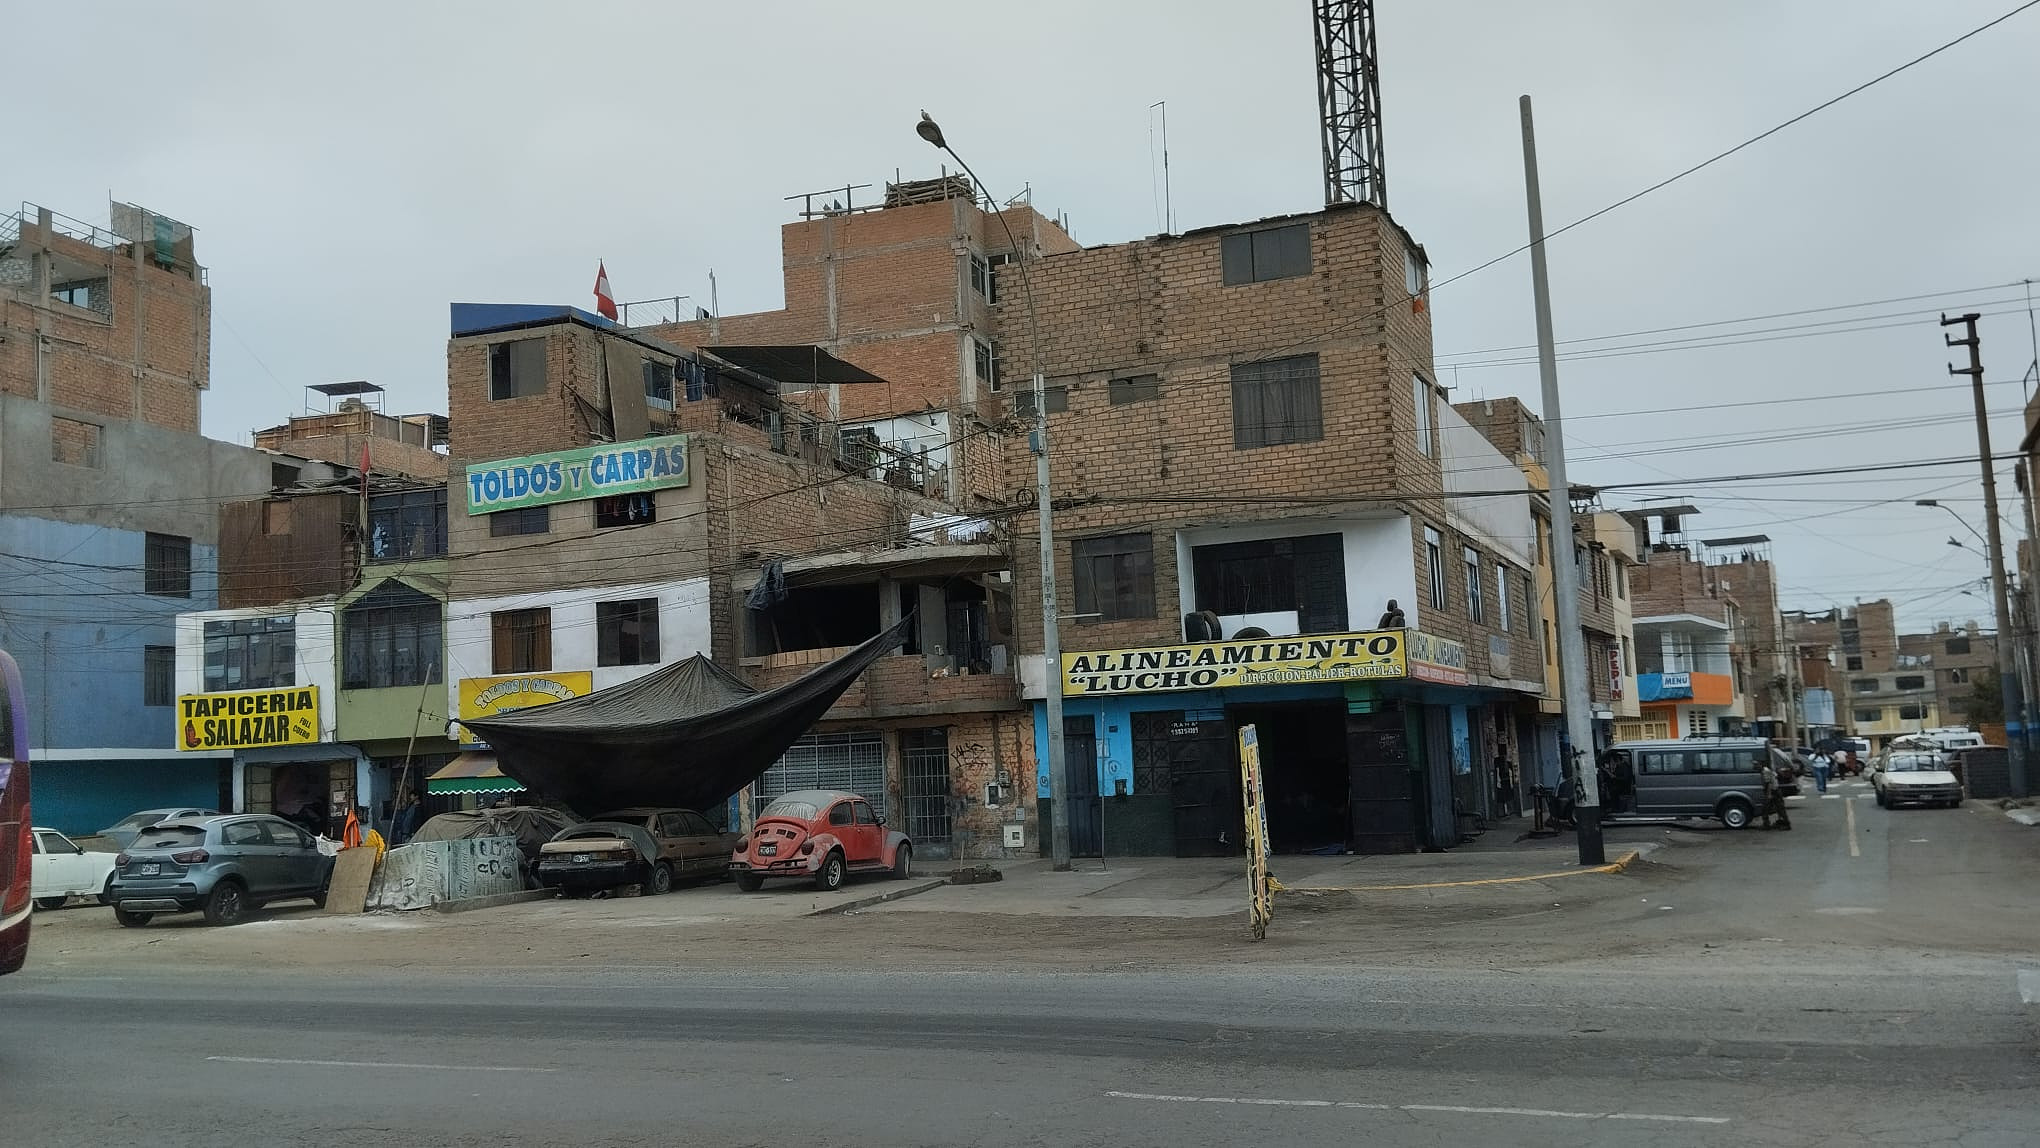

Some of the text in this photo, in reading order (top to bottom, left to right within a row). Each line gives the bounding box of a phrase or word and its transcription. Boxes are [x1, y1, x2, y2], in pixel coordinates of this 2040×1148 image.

[470, 445, 683, 503] TOLDOS Y CARPAS
[1068, 636, 1398, 673] ALINEAMIENTO
[1609, 651, 1622, 699] PEPIN
[1664, 676, 1688, 686] MENU
[181, 691, 314, 718] TAPICERIA
[474, 679, 520, 709] TOLDOS
[520, 678, 531, 692] Y
[203, 715, 290, 746] SALAZAR
